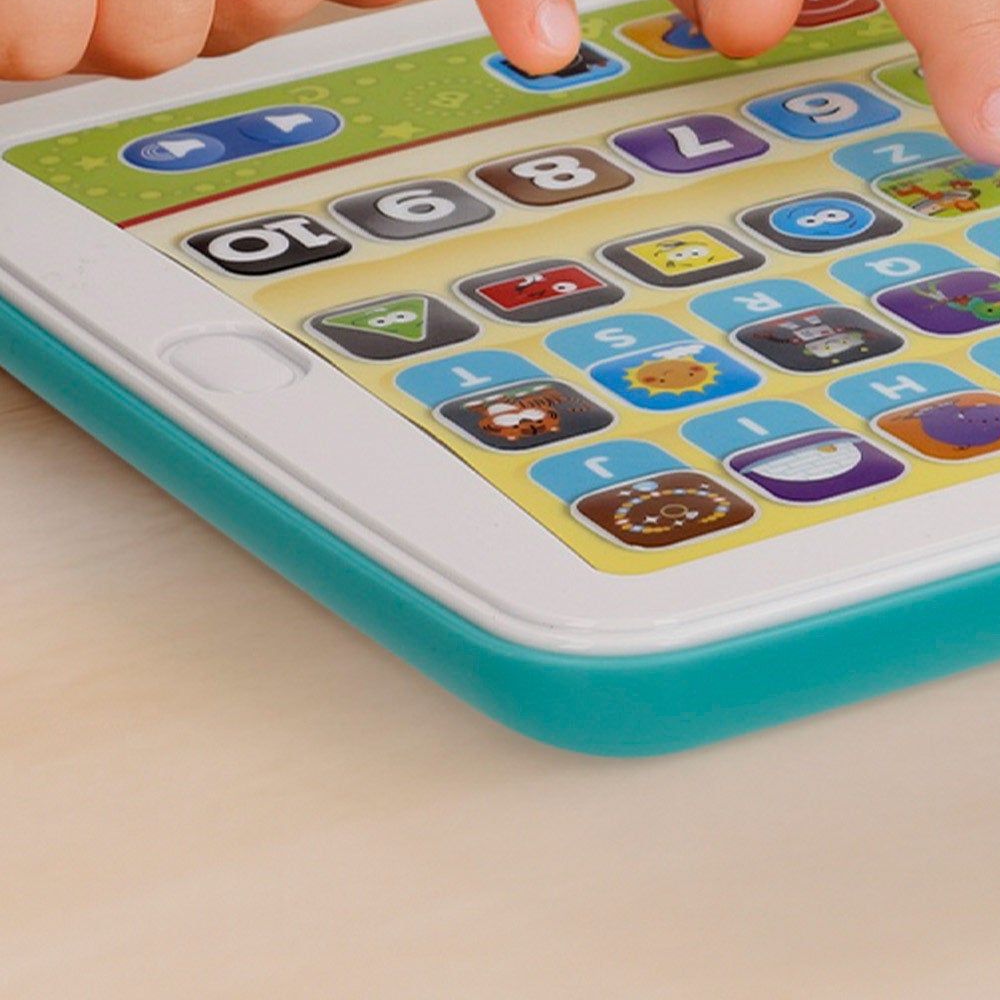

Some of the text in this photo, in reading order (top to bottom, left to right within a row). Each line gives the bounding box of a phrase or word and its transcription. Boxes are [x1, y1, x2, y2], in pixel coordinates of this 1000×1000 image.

[667, 125, 735, 158] 7
[873, 142, 921, 162] Z
[512, 156, 597, 190] 8
[206, 217, 336, 263] 10
[866, 257, 922, 277] Q
[734, 292, 783, 312] R
[593, 327, 637, 348] S
[453, 366, 490, 387] T
[869, 375, 928, 400] H
[737, 418, 769, 435] I
[584, 457, 614, 478] J
